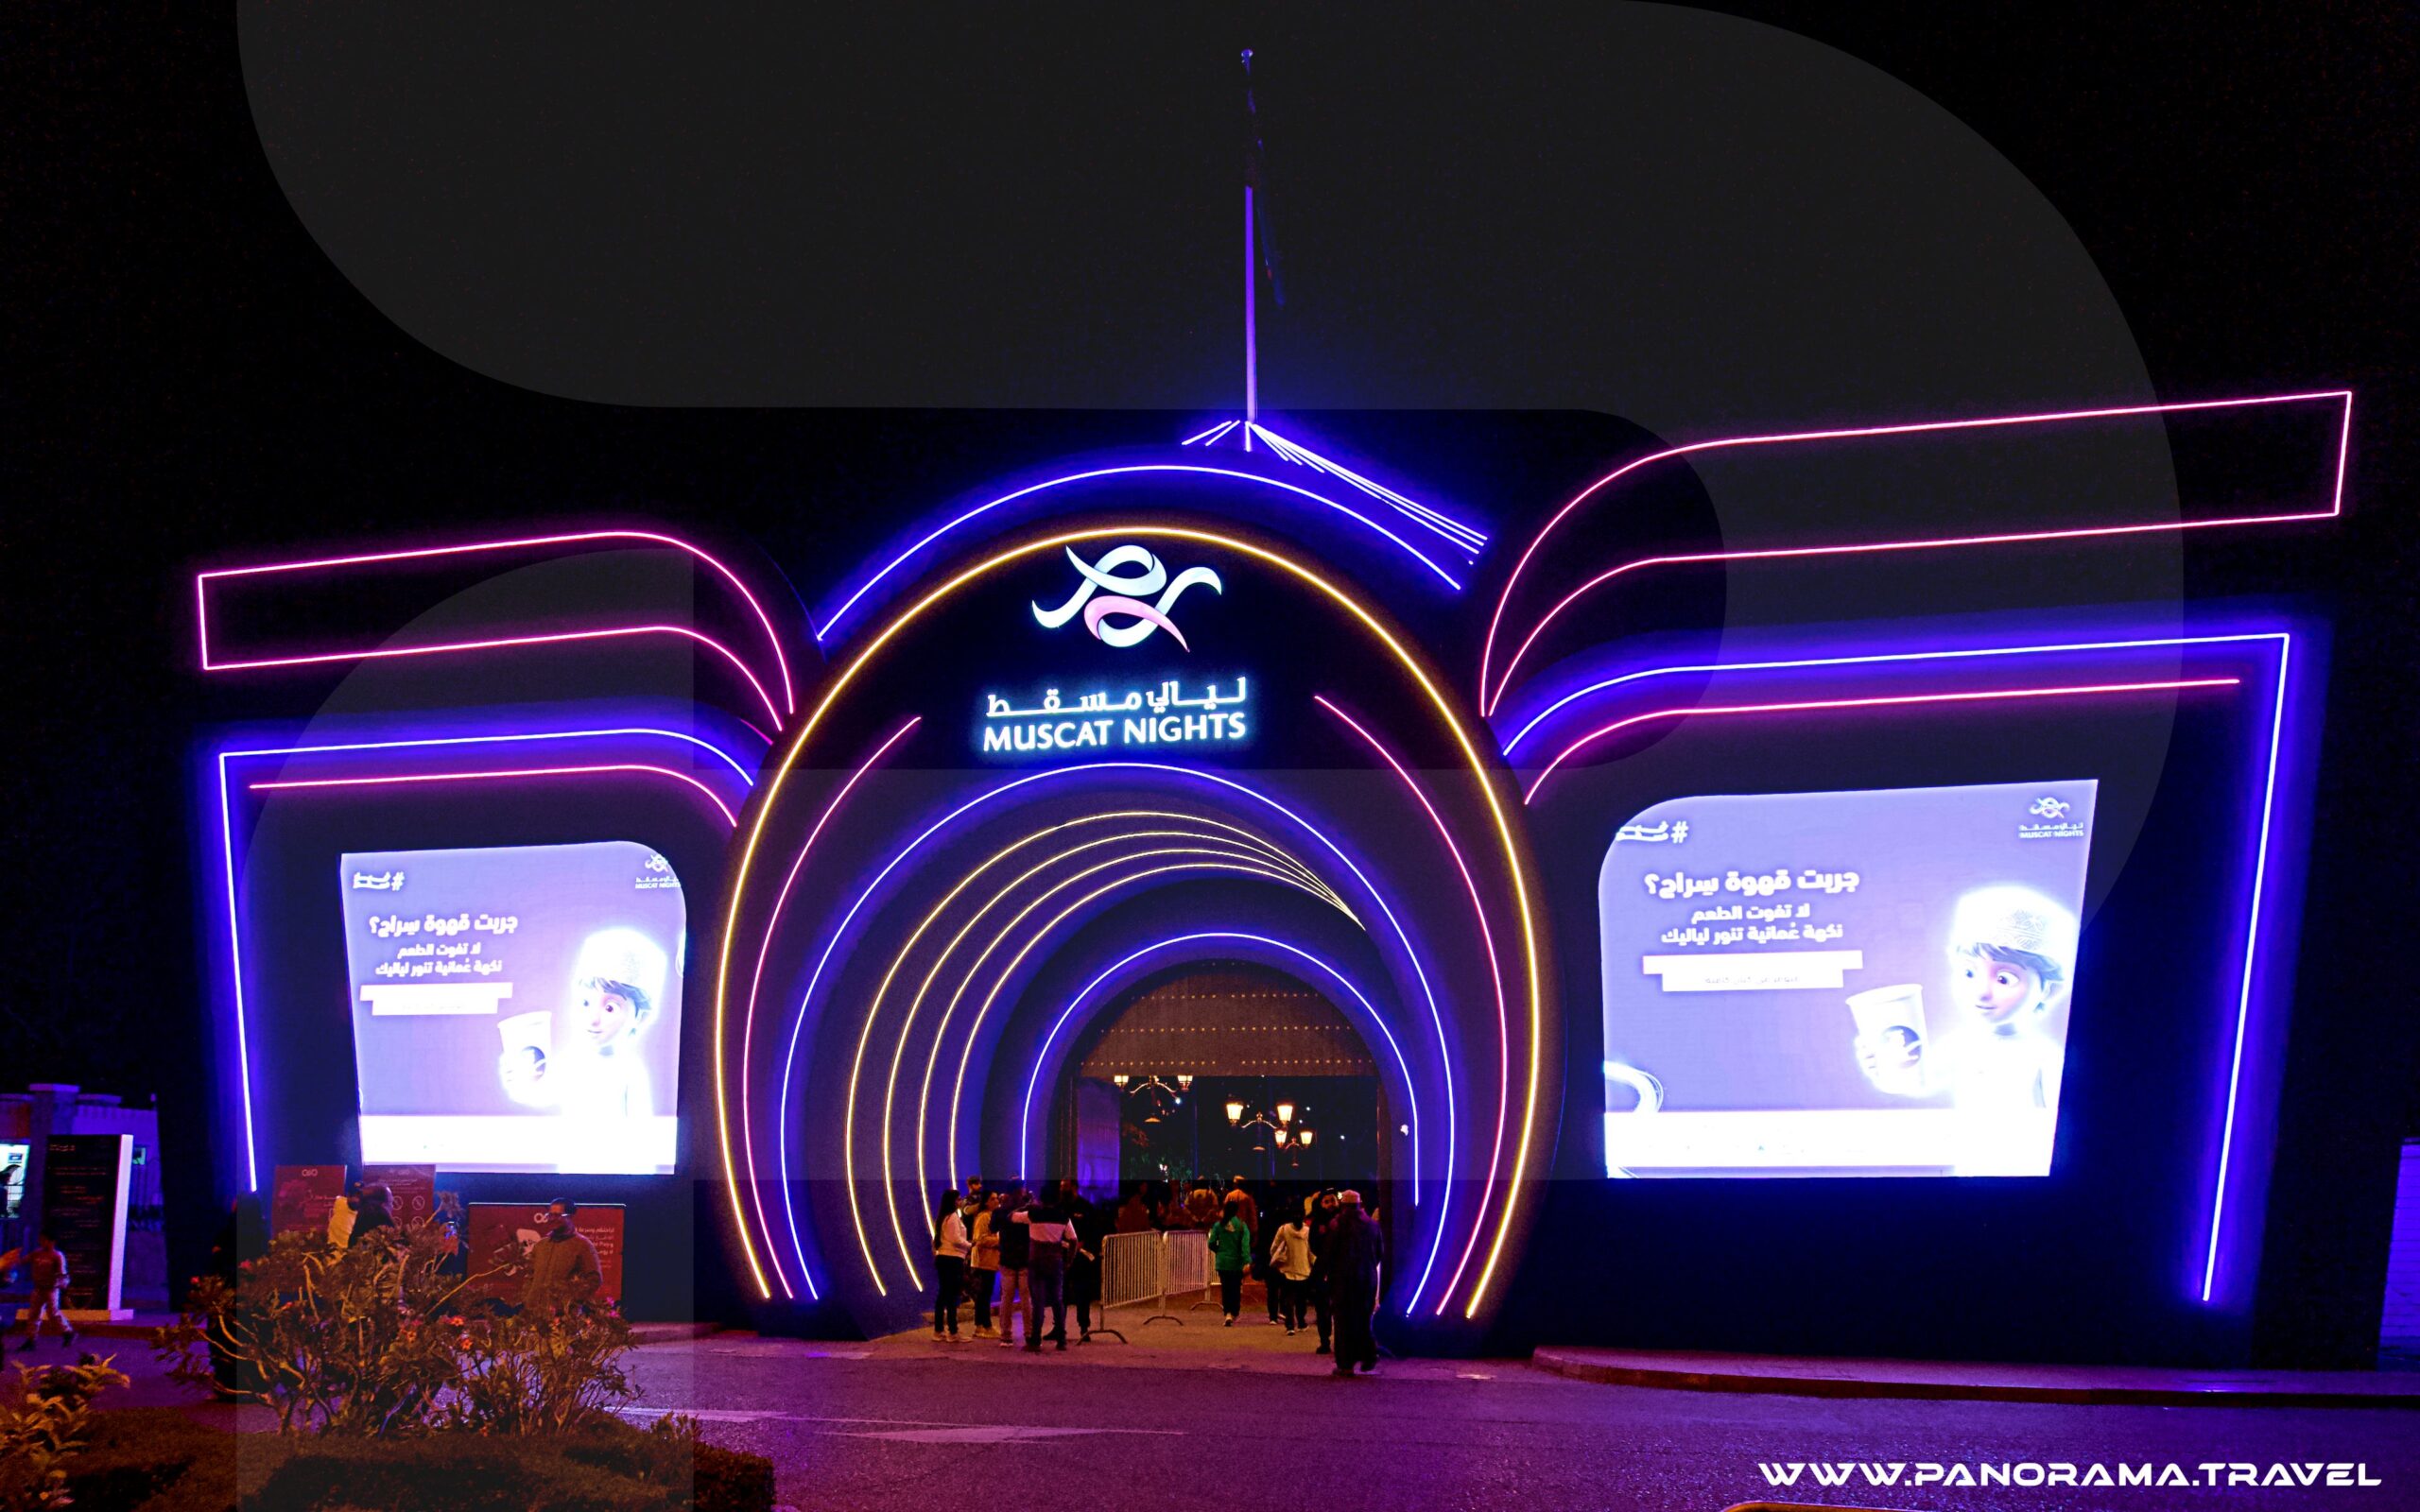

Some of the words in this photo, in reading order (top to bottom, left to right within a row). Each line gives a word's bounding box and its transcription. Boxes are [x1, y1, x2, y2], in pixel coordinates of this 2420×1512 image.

[986, 688, 1142, 717] مسقط
[1145, 676, 1247, 713] ليالي
[983, 719, 1115, 752] MUSCAT
[1123, 712, 1247, 745] NIGHTS
[1724, 868, 1792, 897] قهوة
[1797, 868, 1860, 894] جربت
[1690, 904, 1743, 925] الطعم
[1746, 903, 1793, 922] تفوت
[1795, 902, 1810, 919] لا
[424, 913, 471, 936] قهوة
[474, 913, 519, 936] جربت
[1802, 923, 1843, 943] نكهة
[1660, 927, 1710, 946] لياليك
[1712, 927, 1744, 945] تنور
[396, 943, 435, 959] الطعم
[435, 942, 470, 958] تفوت
[470, 942, 481, 955] لا
[374, 961, 410, 977] لياليك
[409, 962, 434, 977] تنور
